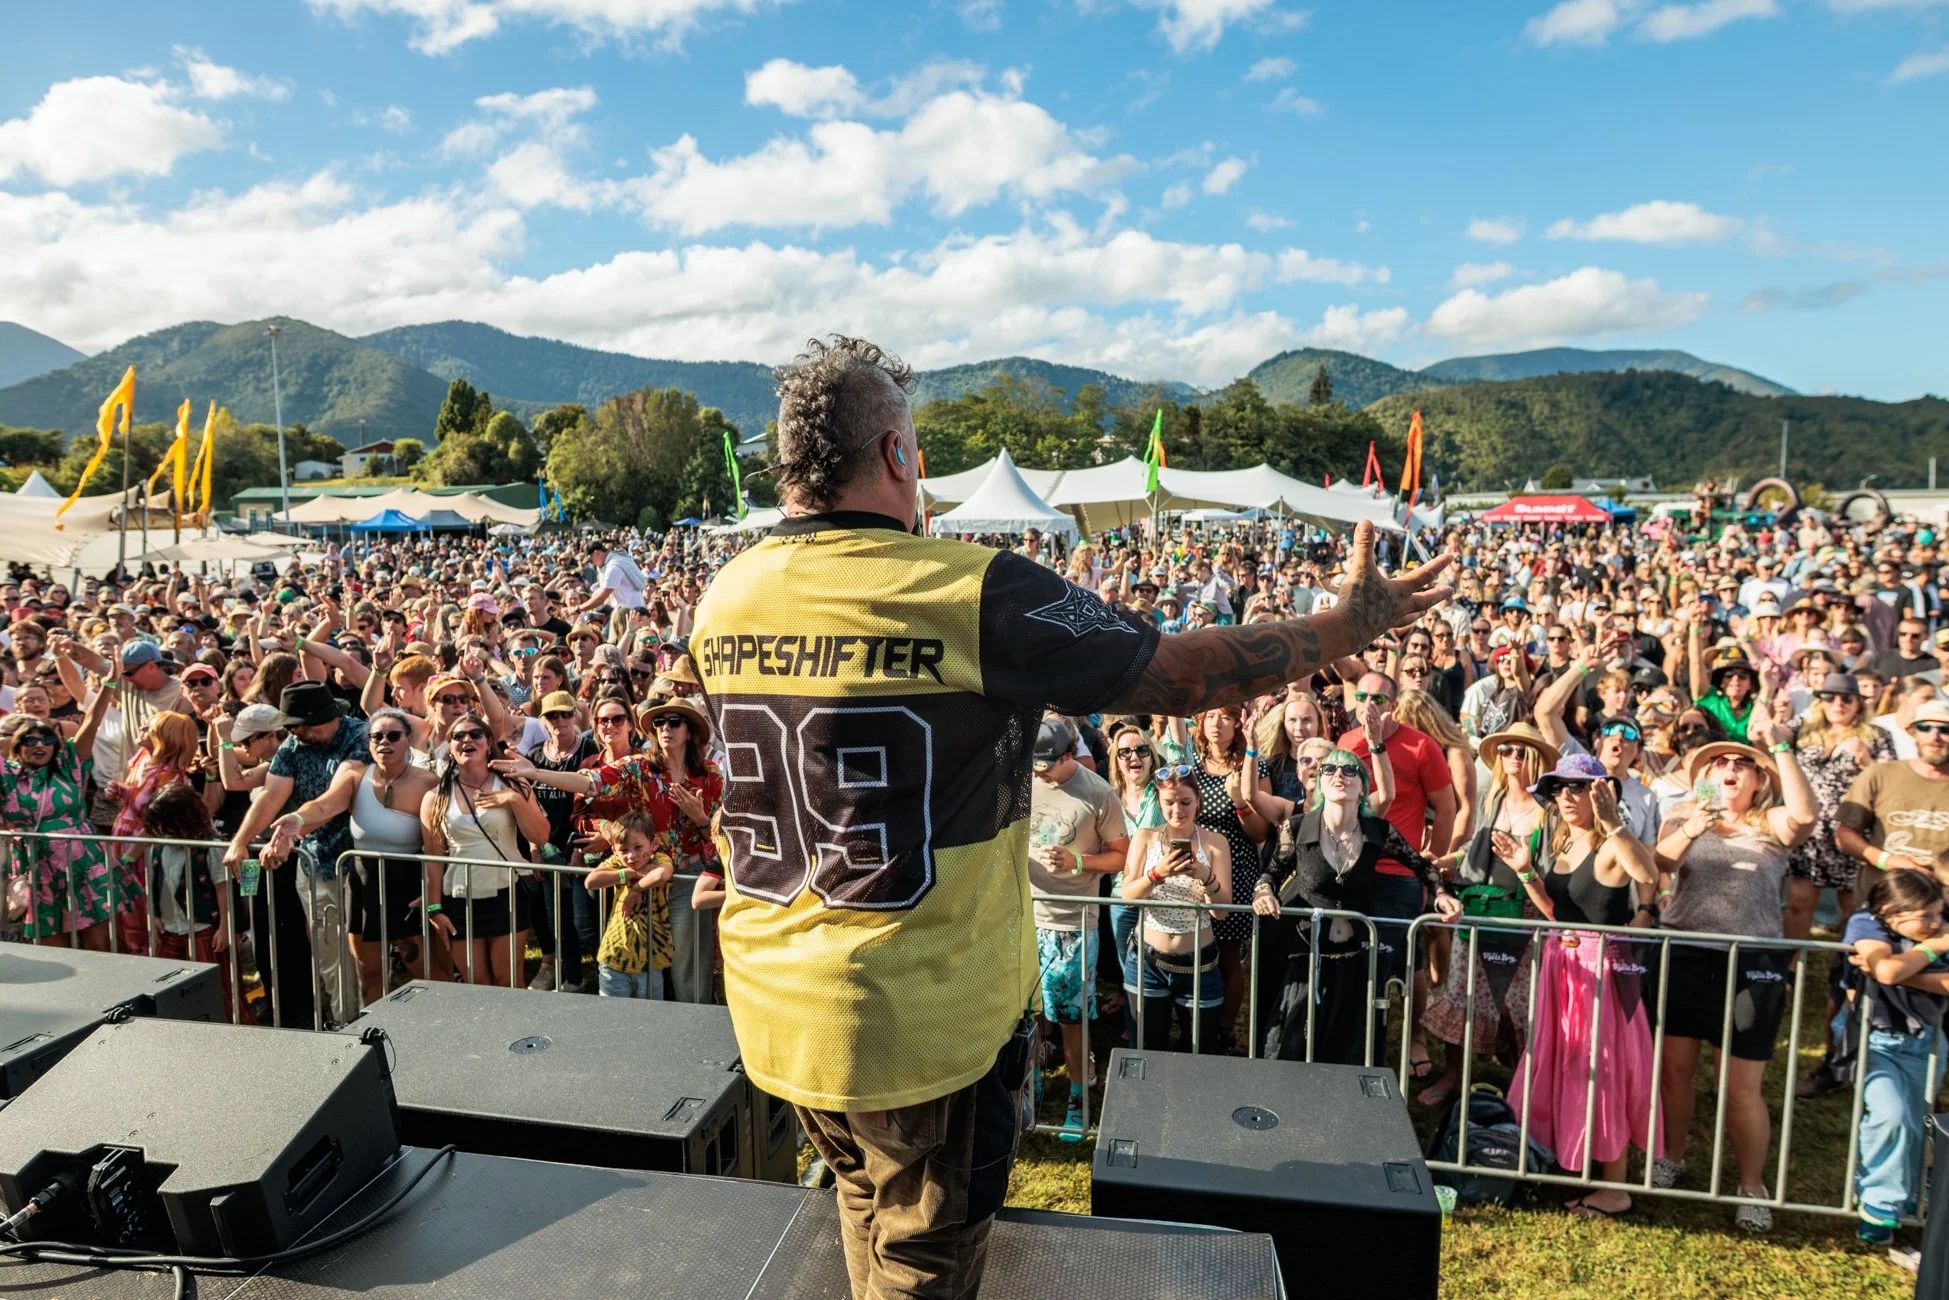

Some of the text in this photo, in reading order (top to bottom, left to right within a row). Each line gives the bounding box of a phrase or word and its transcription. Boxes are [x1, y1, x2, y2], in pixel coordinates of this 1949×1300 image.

[703, 635, 947, 686] SHAPESHIFTER
[538, 790, 566, 799] ET ALIA
[719, 703, 935, 908] 99
